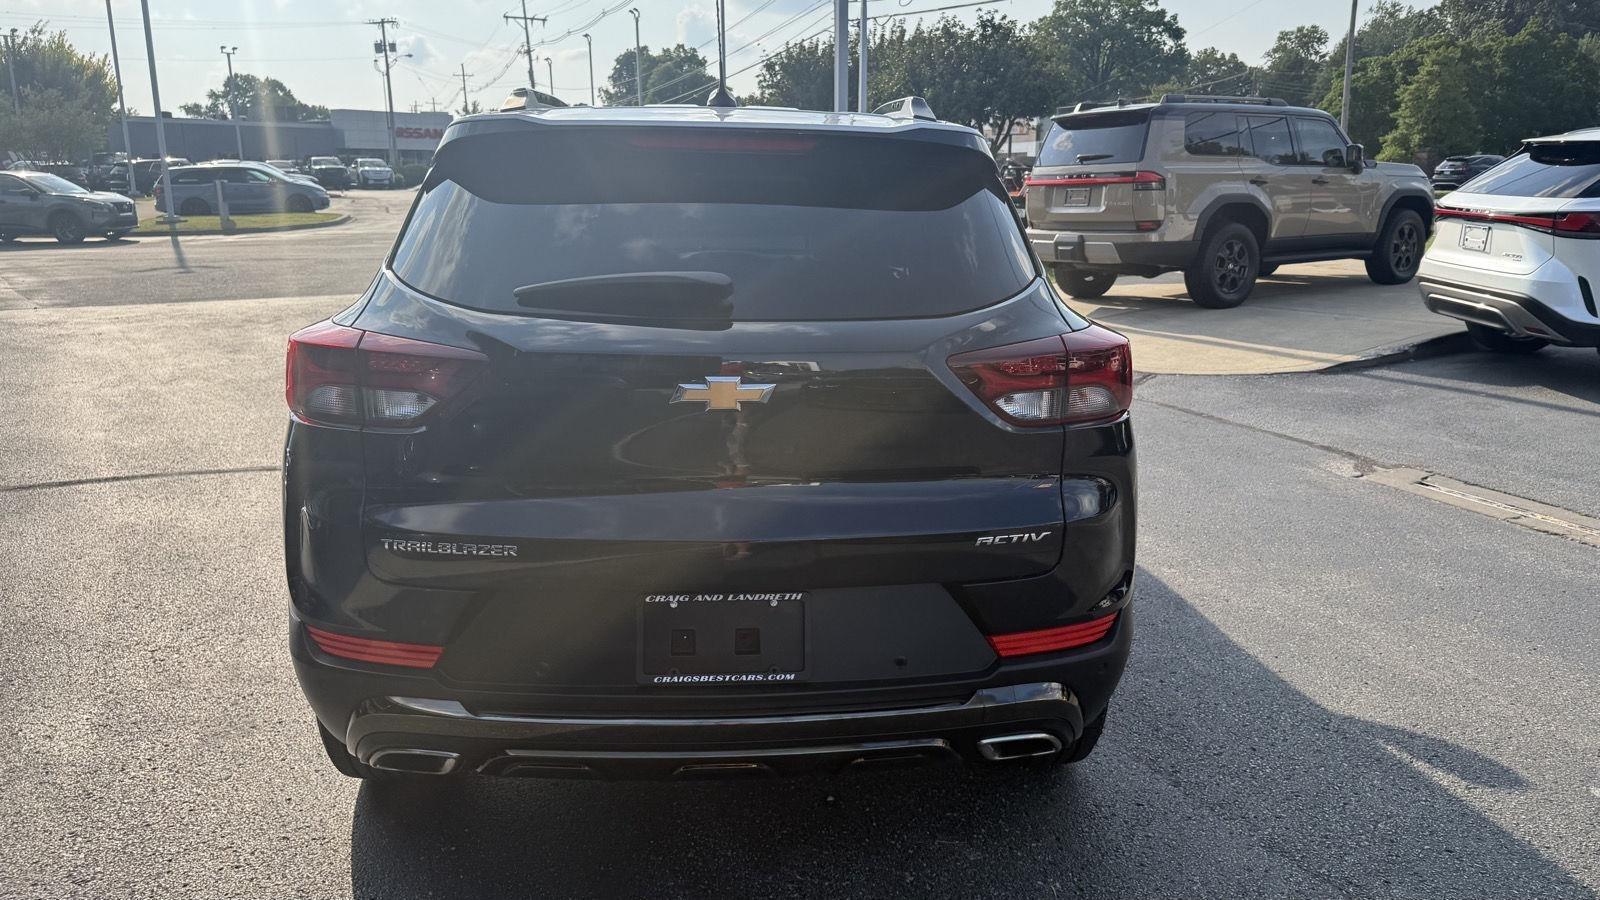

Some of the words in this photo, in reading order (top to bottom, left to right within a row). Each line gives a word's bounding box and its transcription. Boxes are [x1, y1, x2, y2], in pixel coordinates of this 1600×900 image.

[975, 531, 1052, 547] ACTIV
[380, 538, 518, 557] TRAILBLAZER
[645, 594, 690, 603] CRAIG
[693, 593, 724, 602] AND
[727, 592, 803, 601] LANDRETH
[653, 673, 796, 683] CRAIGSBESTCARS.COM
